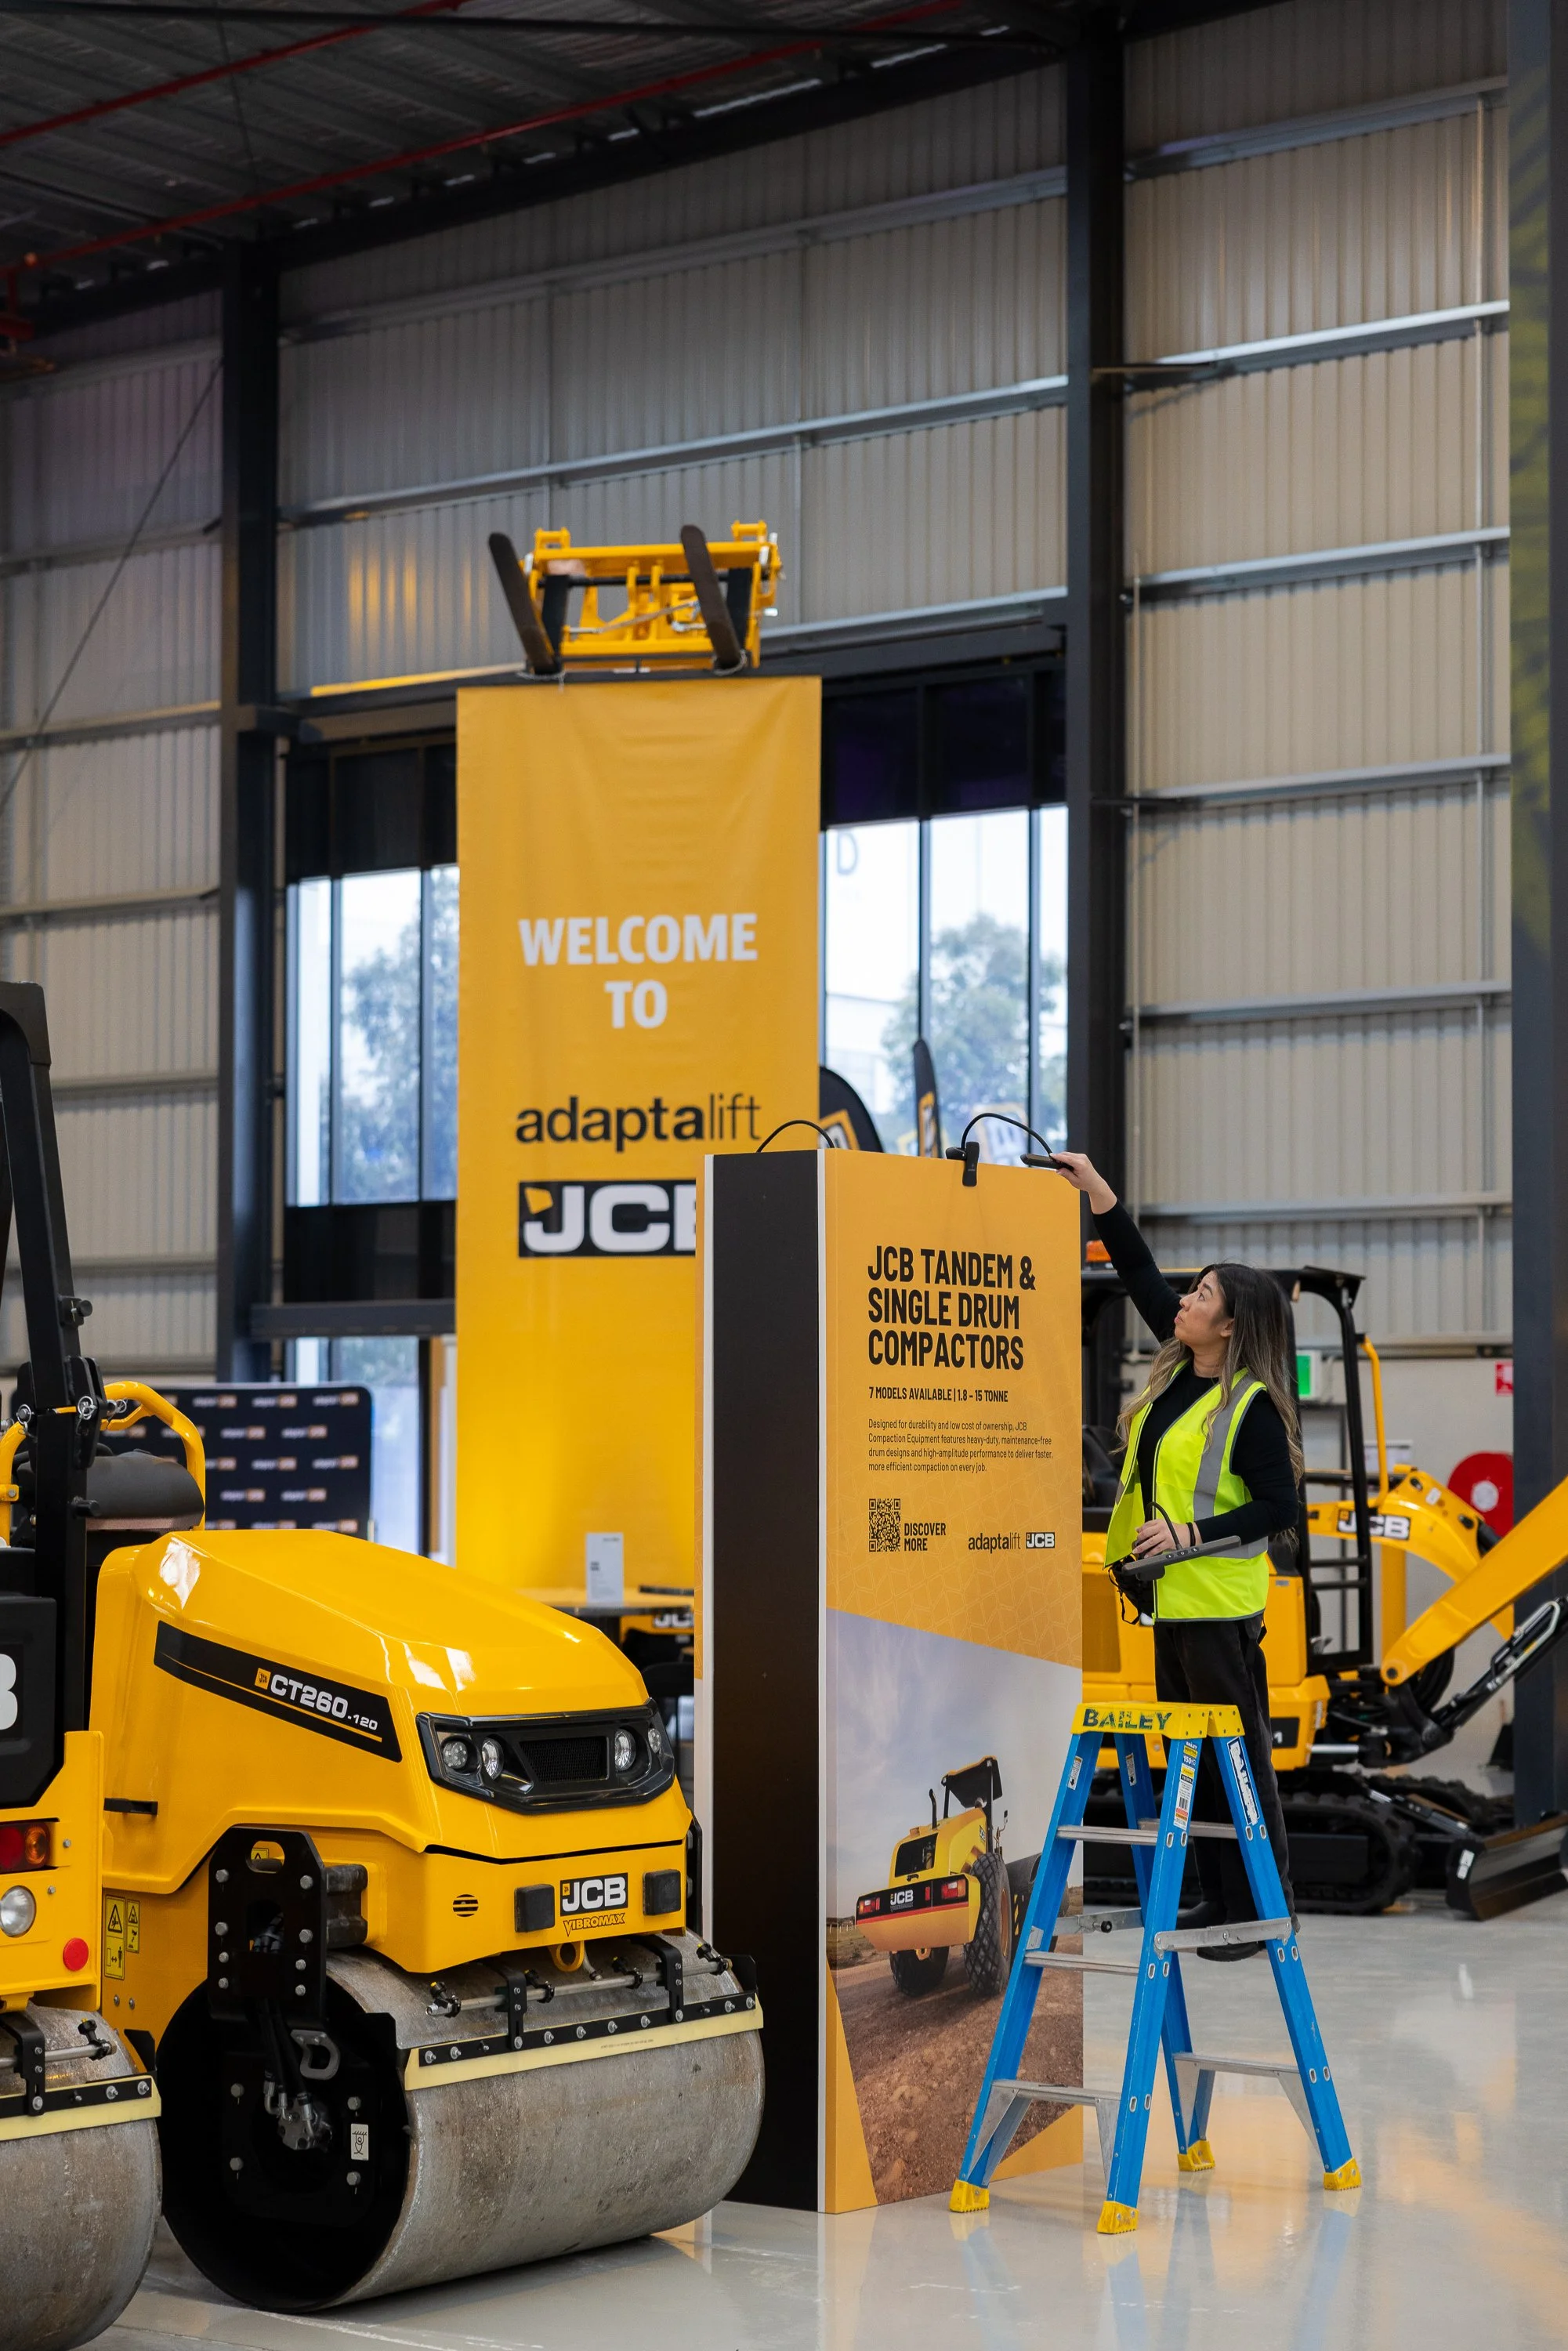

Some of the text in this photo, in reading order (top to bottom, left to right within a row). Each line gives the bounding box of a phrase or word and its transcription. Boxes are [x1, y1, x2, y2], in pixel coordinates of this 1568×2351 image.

[518, 913, 758, 966] WELCOME
[605, 980, 668, 1028] TO
[515, 1092, 762, 1154] adaptalift
[523, 1184, 696, 1253] JC
[867, 1245, 1036, 1291] JCB TANDEM &
[868, 1287, 1019, 1330] SINGLE DRUM
[868, 1329, 1024, 1371] COMPACTORS
[869, 1386, 874, 1399] 7
[875, 1386, 907, 1400] MODELS
[909, 1387, 952, 1400] AVAILABLE
[958, 1389, 968, 1401] 1.8
[975, 1389, 983, 1402] 15
[984, 1389, 1009, 1402] TONNE
[868, 1418, 1027, 1433] Designed for durability and low cost of ownership, JCB
[868, 1433, 1052, 1446] Compaction Equipment features heavy-duty, maintenance-free
[868, 1447, 885, 1457] drum
[886, 1448, 910, 1458] designs
[911, 1448, 922, 1457] and
[923, 1447, 969, 1459] high-amplitude
[970, 1449, 1007, 1459] performance
[1015, 1449, 1034, 1458] deliver
[1035, 1449, 1053, 1459] faster,
[868, 1462, 885, 1471] more
[886, 1462, 912, 1471] efficient
[913, 1462, 949, 1473] compaction
[958, 1464, 975, 1473] every
[976, 1462, 987, 1473] job.
[904, 1522, 946, 1536] DISCOVER
[904, 1538, 928, 1552] MORE
[968, 1532, 1055, 1554] adaptalift JCB
[1082, 1708, 1172, 1730] BAILEY
[562, 1876, 626, 1912] JCB
[890, 1889, 914, 1905] JCB
[563, 1912, 625, 1937] VIBROMAX
